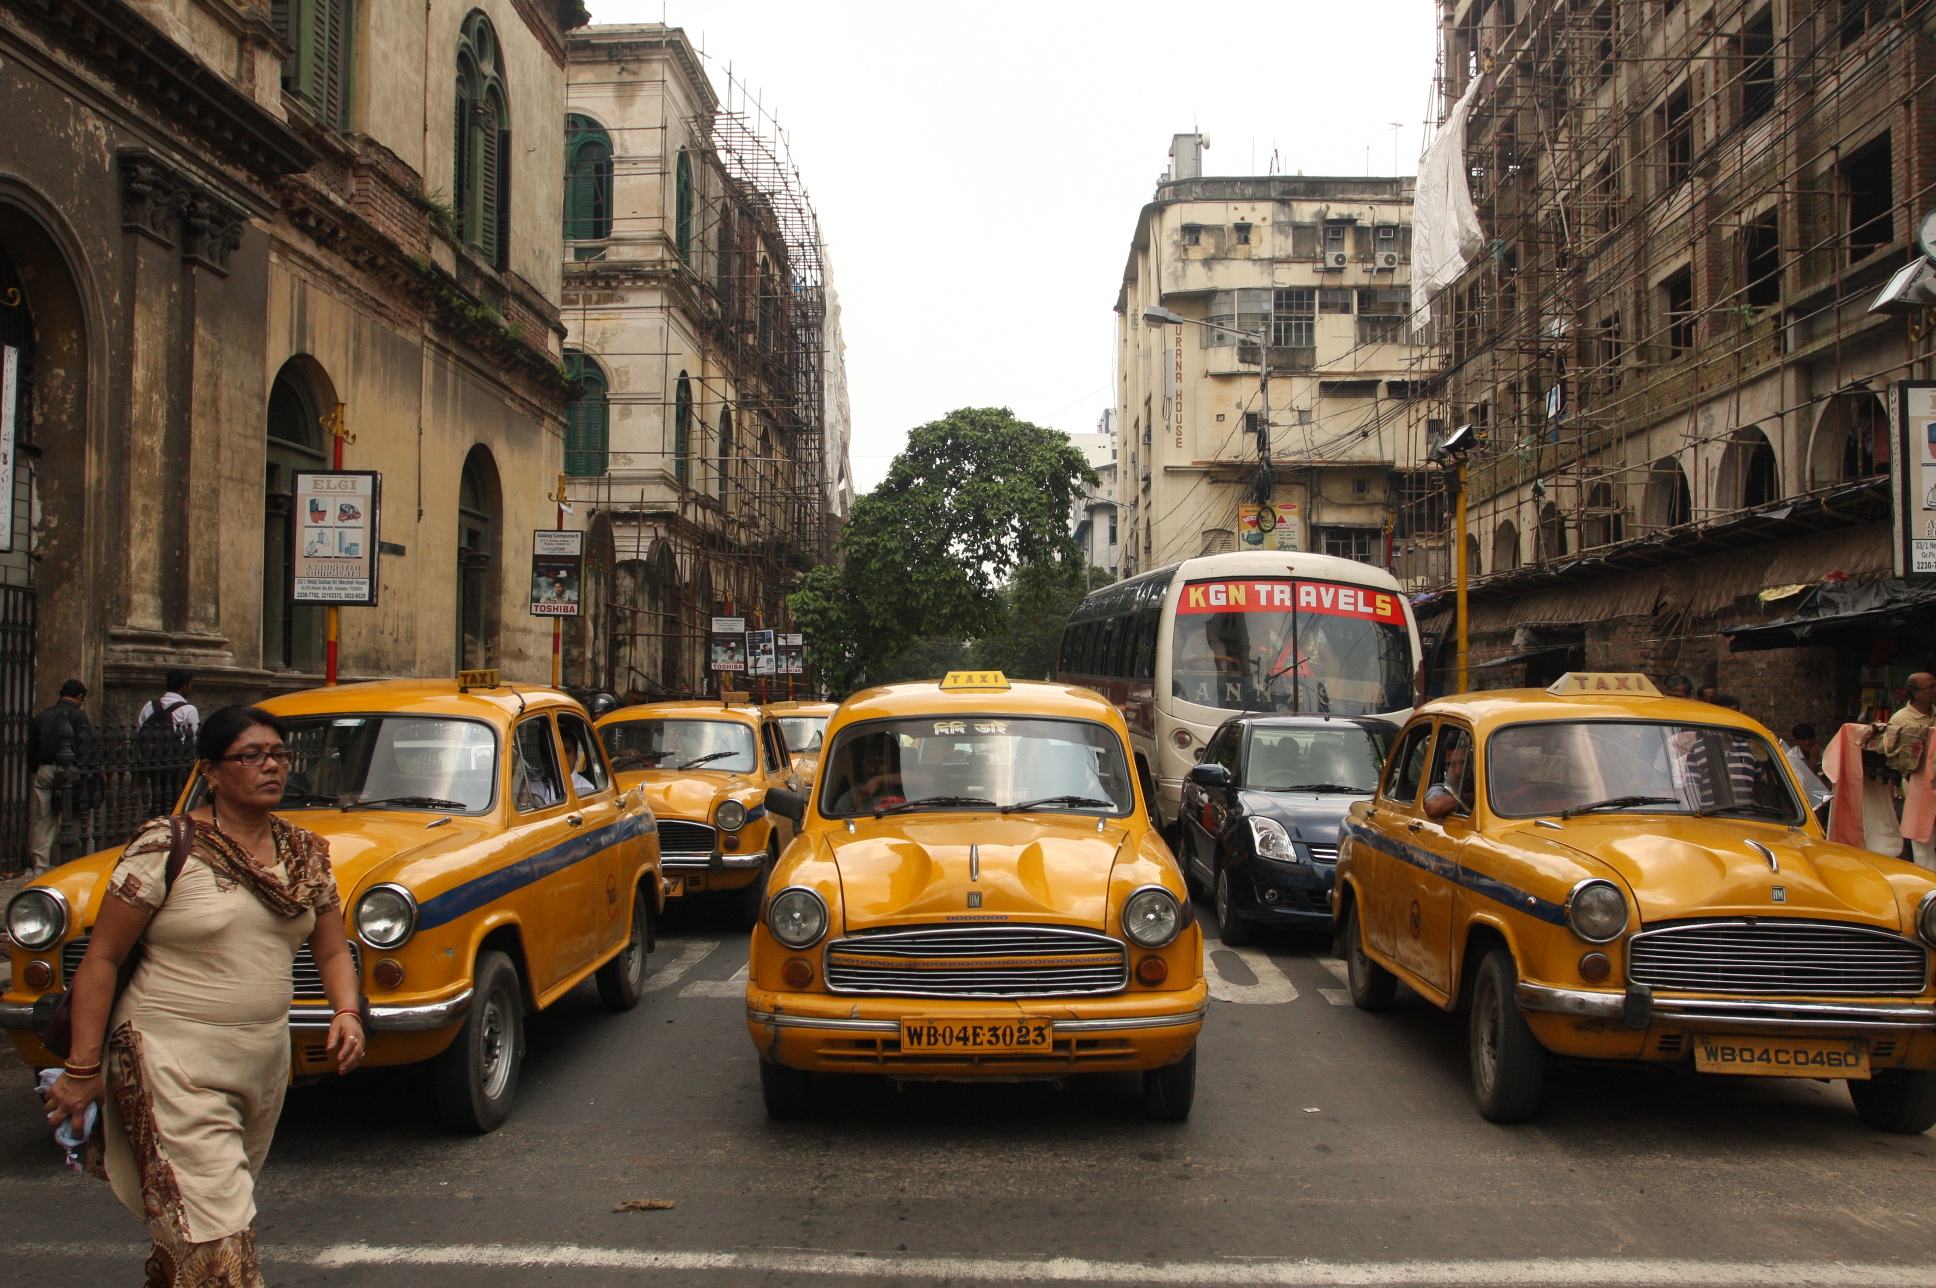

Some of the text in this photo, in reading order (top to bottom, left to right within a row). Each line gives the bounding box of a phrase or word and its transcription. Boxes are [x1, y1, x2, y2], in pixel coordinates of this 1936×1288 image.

[1175, 313, 1183, 448] URANA HOUSE
[312, 479, 357, 490] ELGI
[1915, 541, 1929, 551] 33/1
[1189, 584, 1392, 617] KGN TRAVELS
[533, 604, 576, 613] TOSHIBA
[460, 672, 495, 685] TAXI
[951, 674, 999, 684] TAXI
[1573, 675, 1643, 690] TAXI
[996, 790, 1028, 799] FOR HIRE
[1772, 889, 1784, 900] HM
[968, 894, 980, 907] HM
